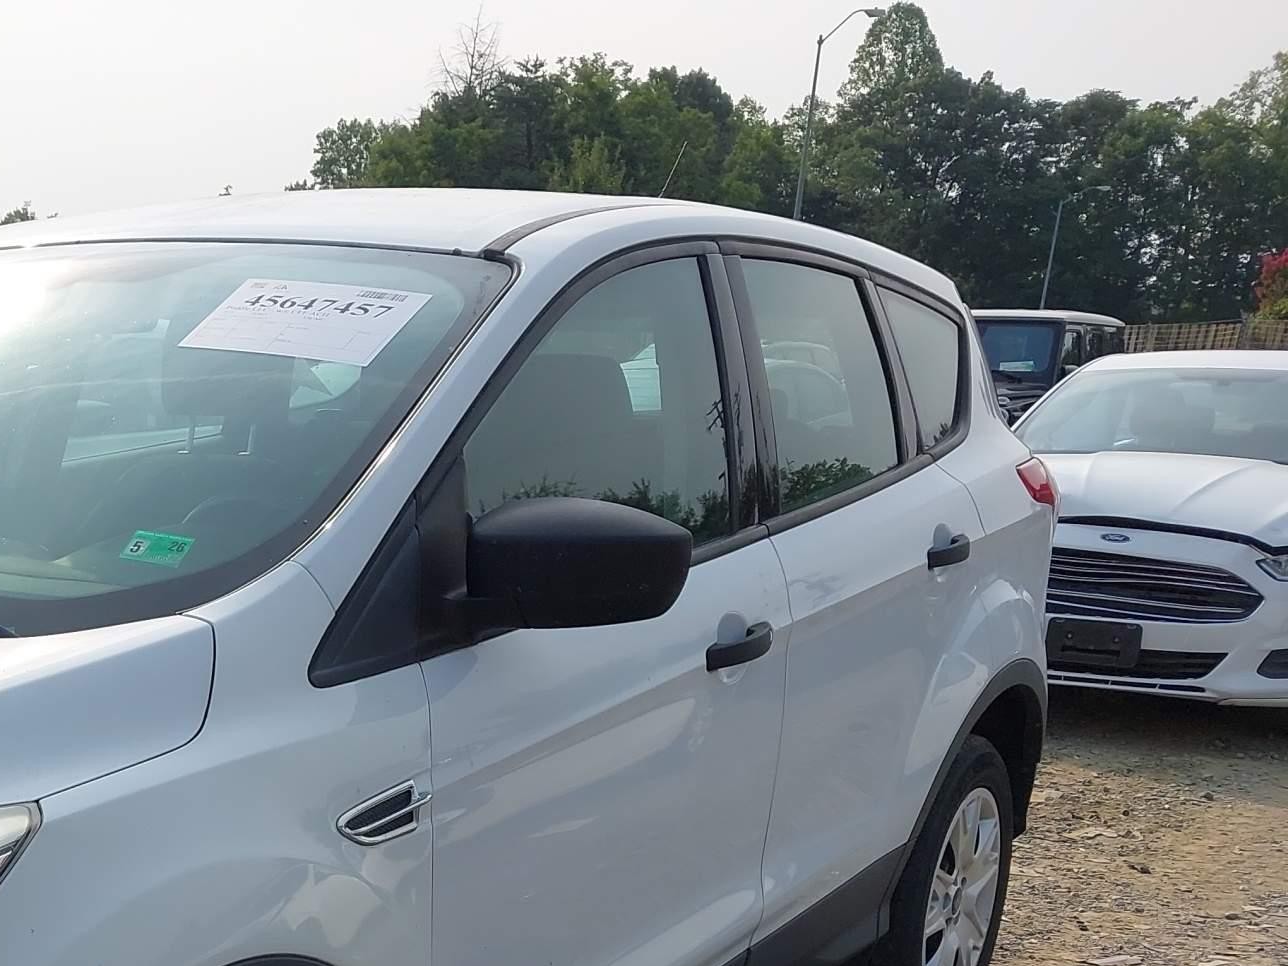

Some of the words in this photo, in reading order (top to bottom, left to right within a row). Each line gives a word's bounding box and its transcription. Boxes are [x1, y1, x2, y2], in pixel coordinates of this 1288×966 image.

[244, 294, 394, 318] 45647457
[130, 541, 144, 553] 5
[167, 541, 188, 553] 26
